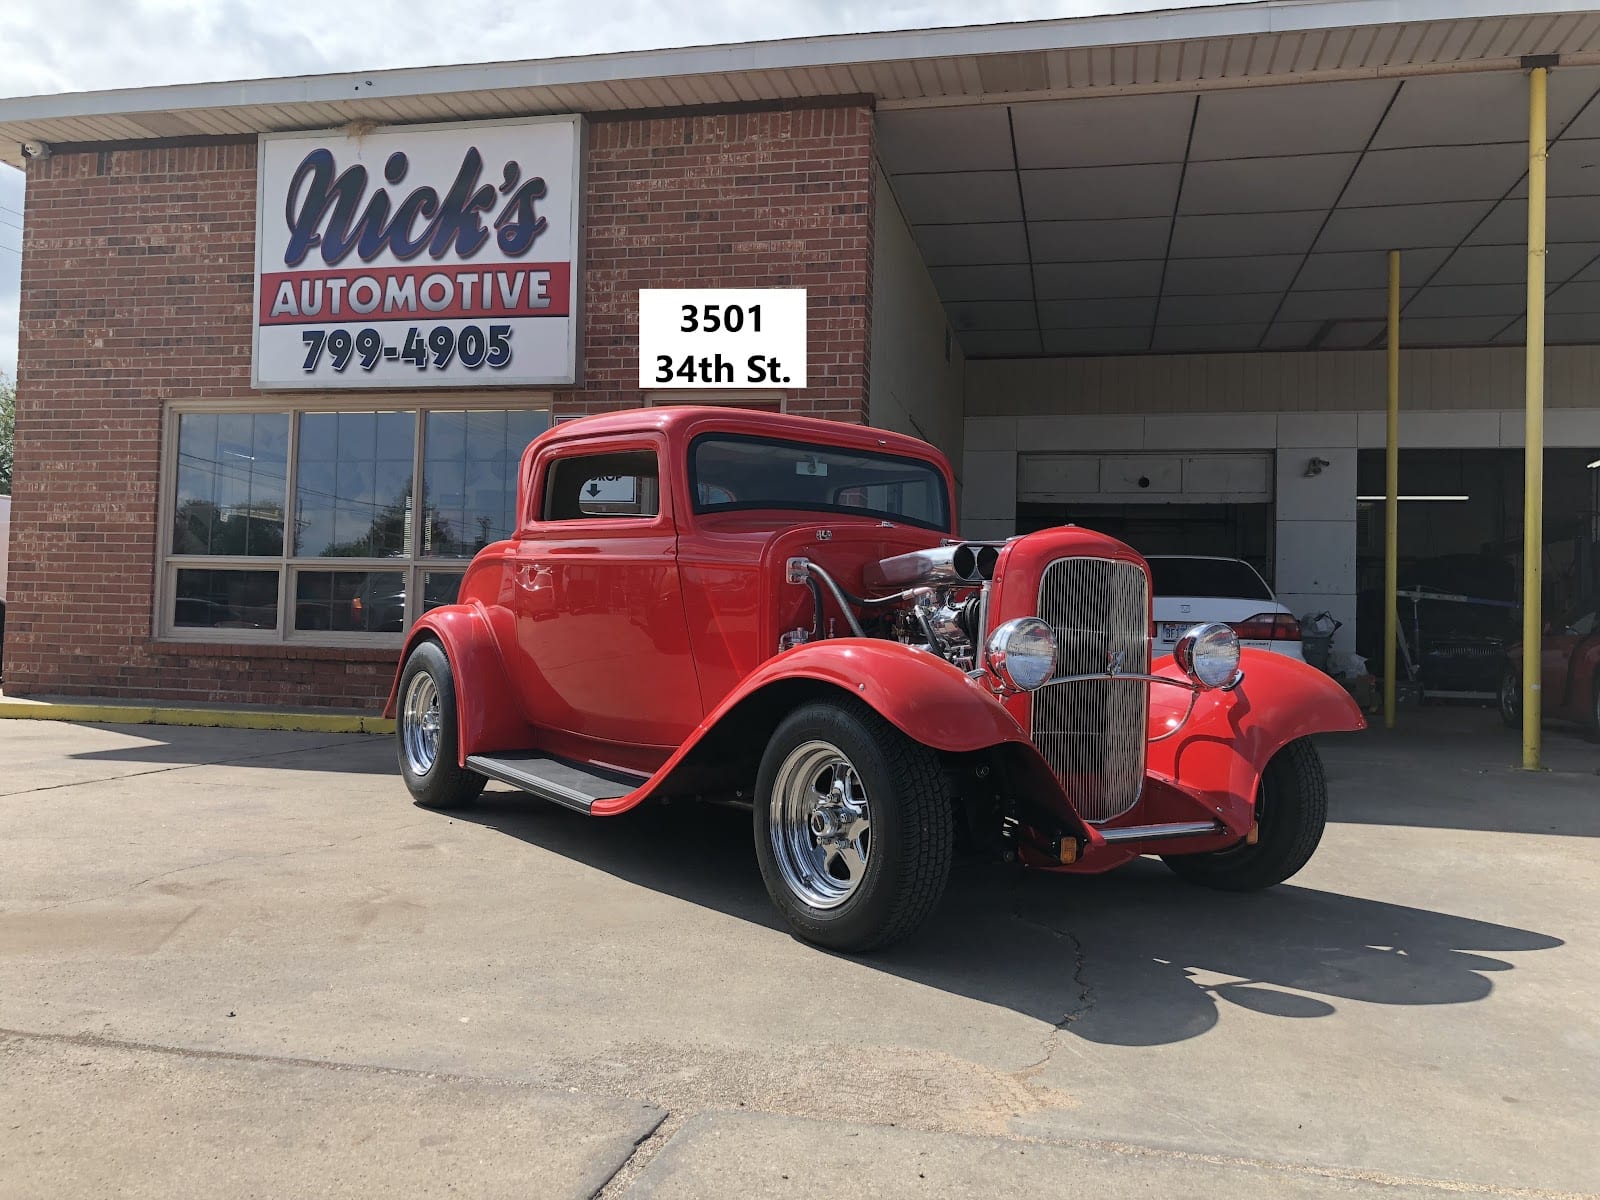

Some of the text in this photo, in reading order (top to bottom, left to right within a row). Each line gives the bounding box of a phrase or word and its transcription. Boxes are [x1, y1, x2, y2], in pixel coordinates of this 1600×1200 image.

[284, 145, 548, 268] Nick's
[270, 270, 552, 318] AUTOMOTIVE
[301, 324, 513, 372] 799-4905
